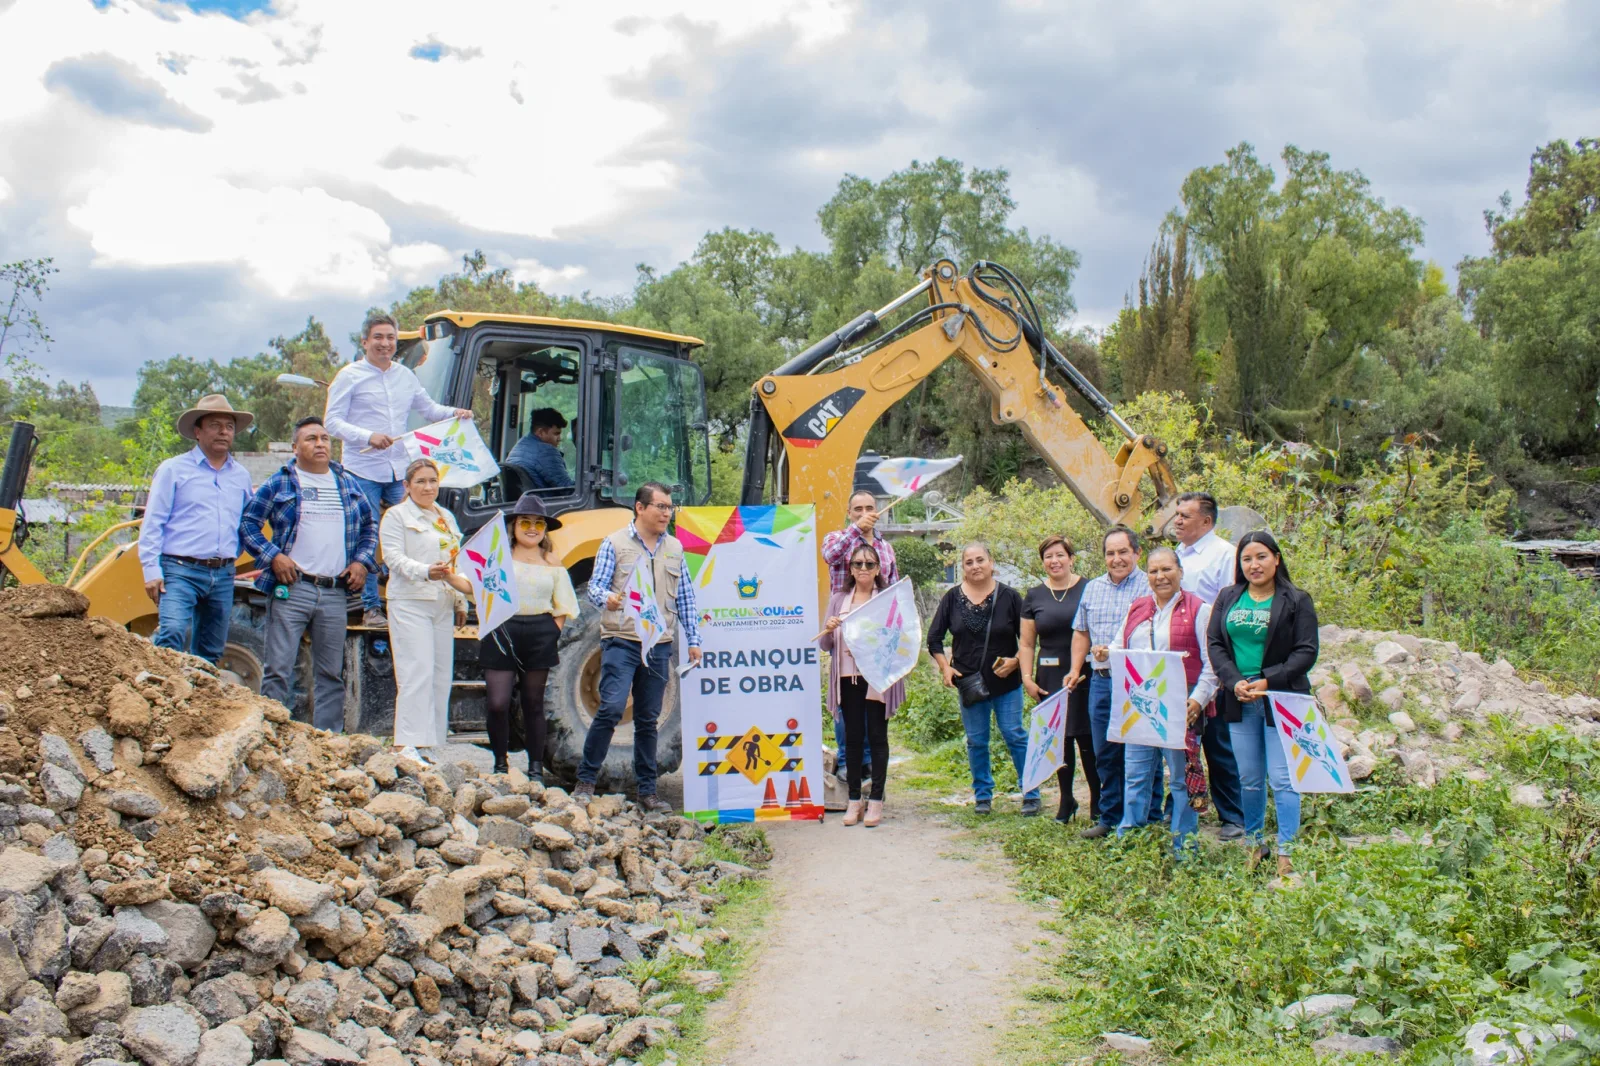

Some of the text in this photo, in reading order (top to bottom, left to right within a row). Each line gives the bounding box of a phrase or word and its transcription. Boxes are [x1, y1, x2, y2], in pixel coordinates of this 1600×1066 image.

[808, 399, 843, 438] CAT
[688, 648, 817, 669] RRANQUE
[700, 674, 804, 695] DE OBRA
